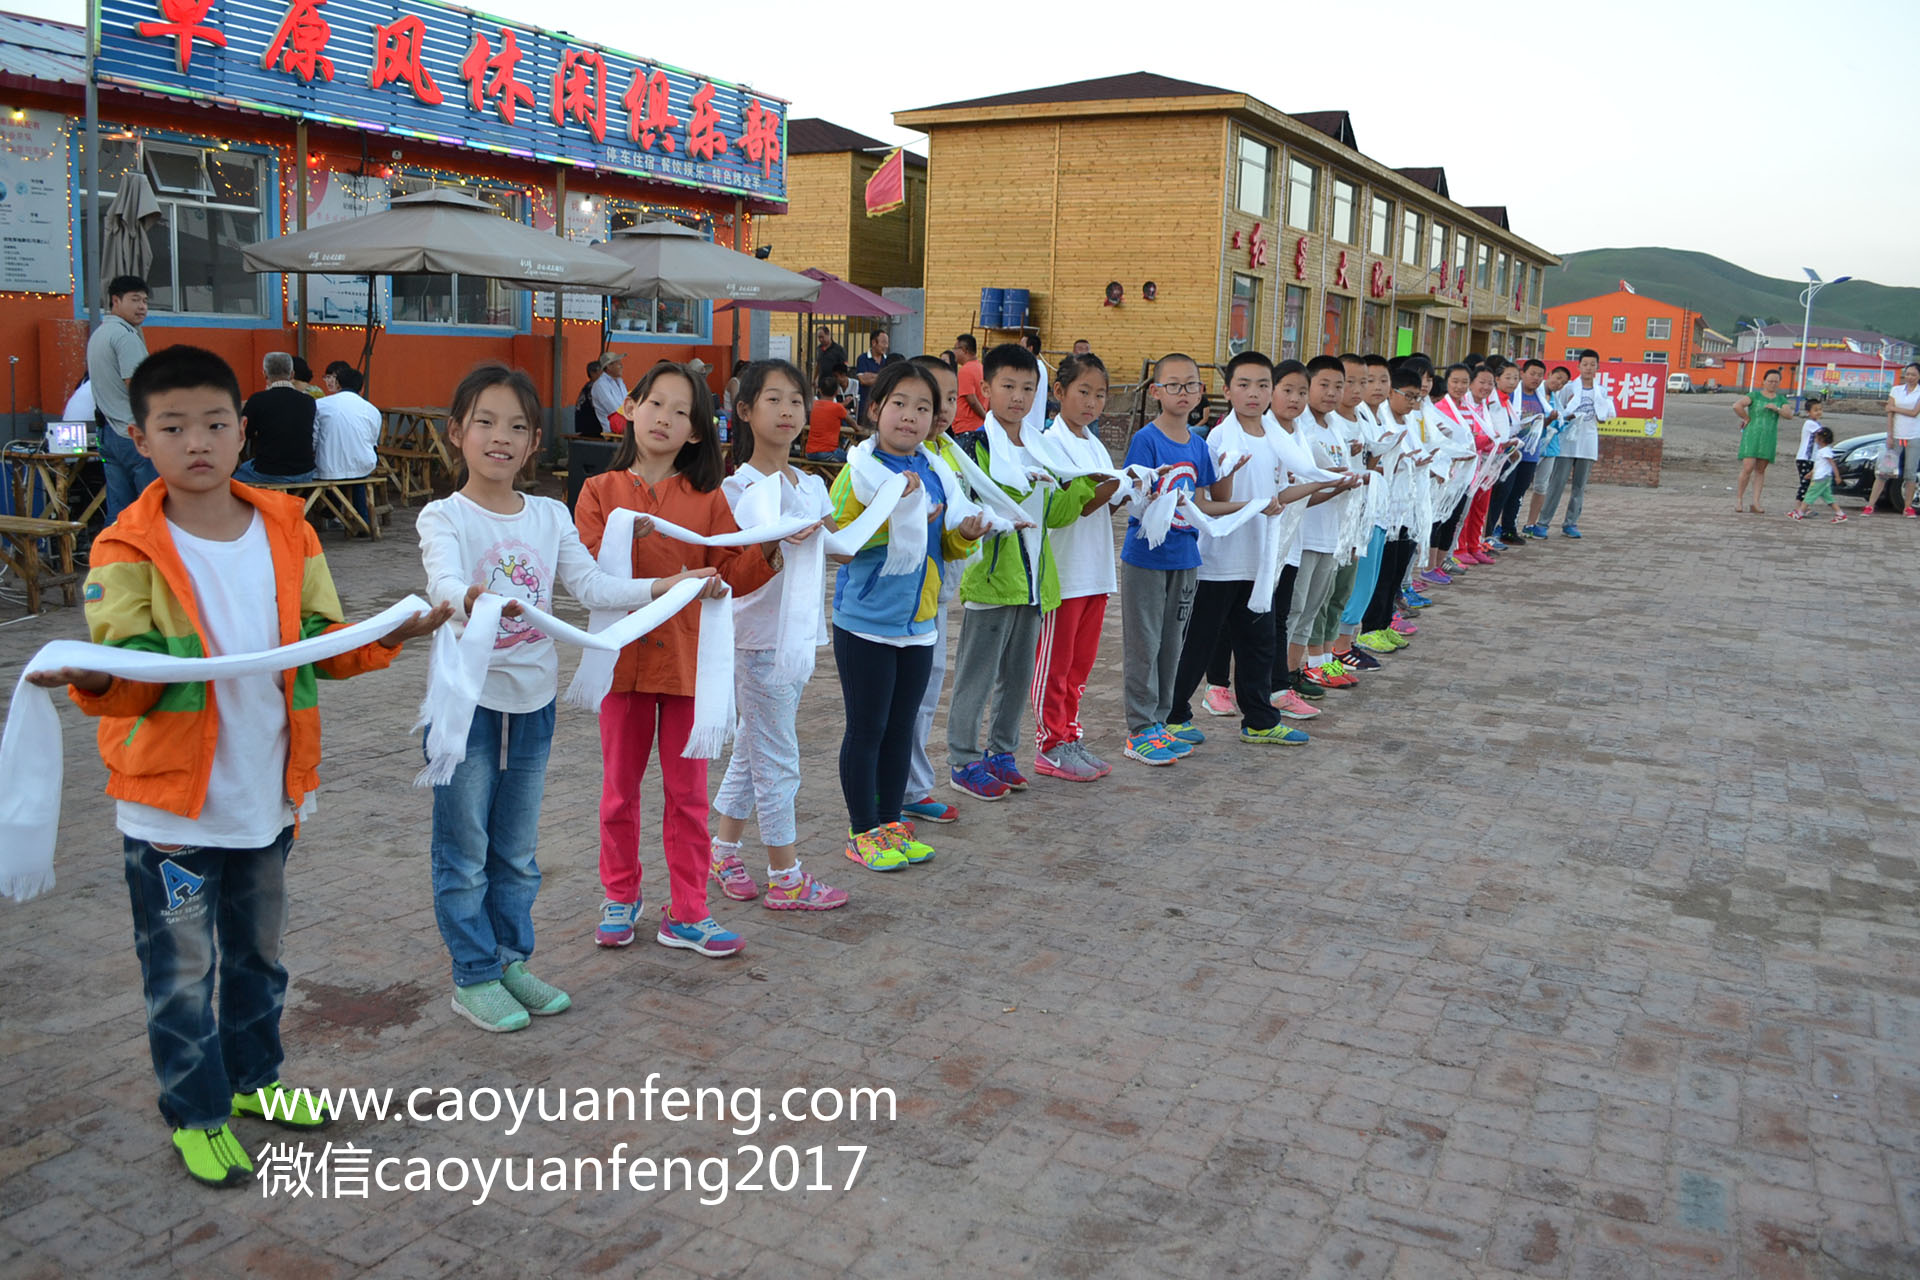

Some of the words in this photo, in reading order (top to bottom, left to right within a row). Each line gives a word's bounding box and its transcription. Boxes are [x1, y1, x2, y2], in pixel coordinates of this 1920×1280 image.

[606, 146, 656, 171] 停车住宿
[661, 157, 705, 180] 餐饮娱乐
[711, 167, 763, 190] 特色烤全羊
[159, 858, 205, 911] A
